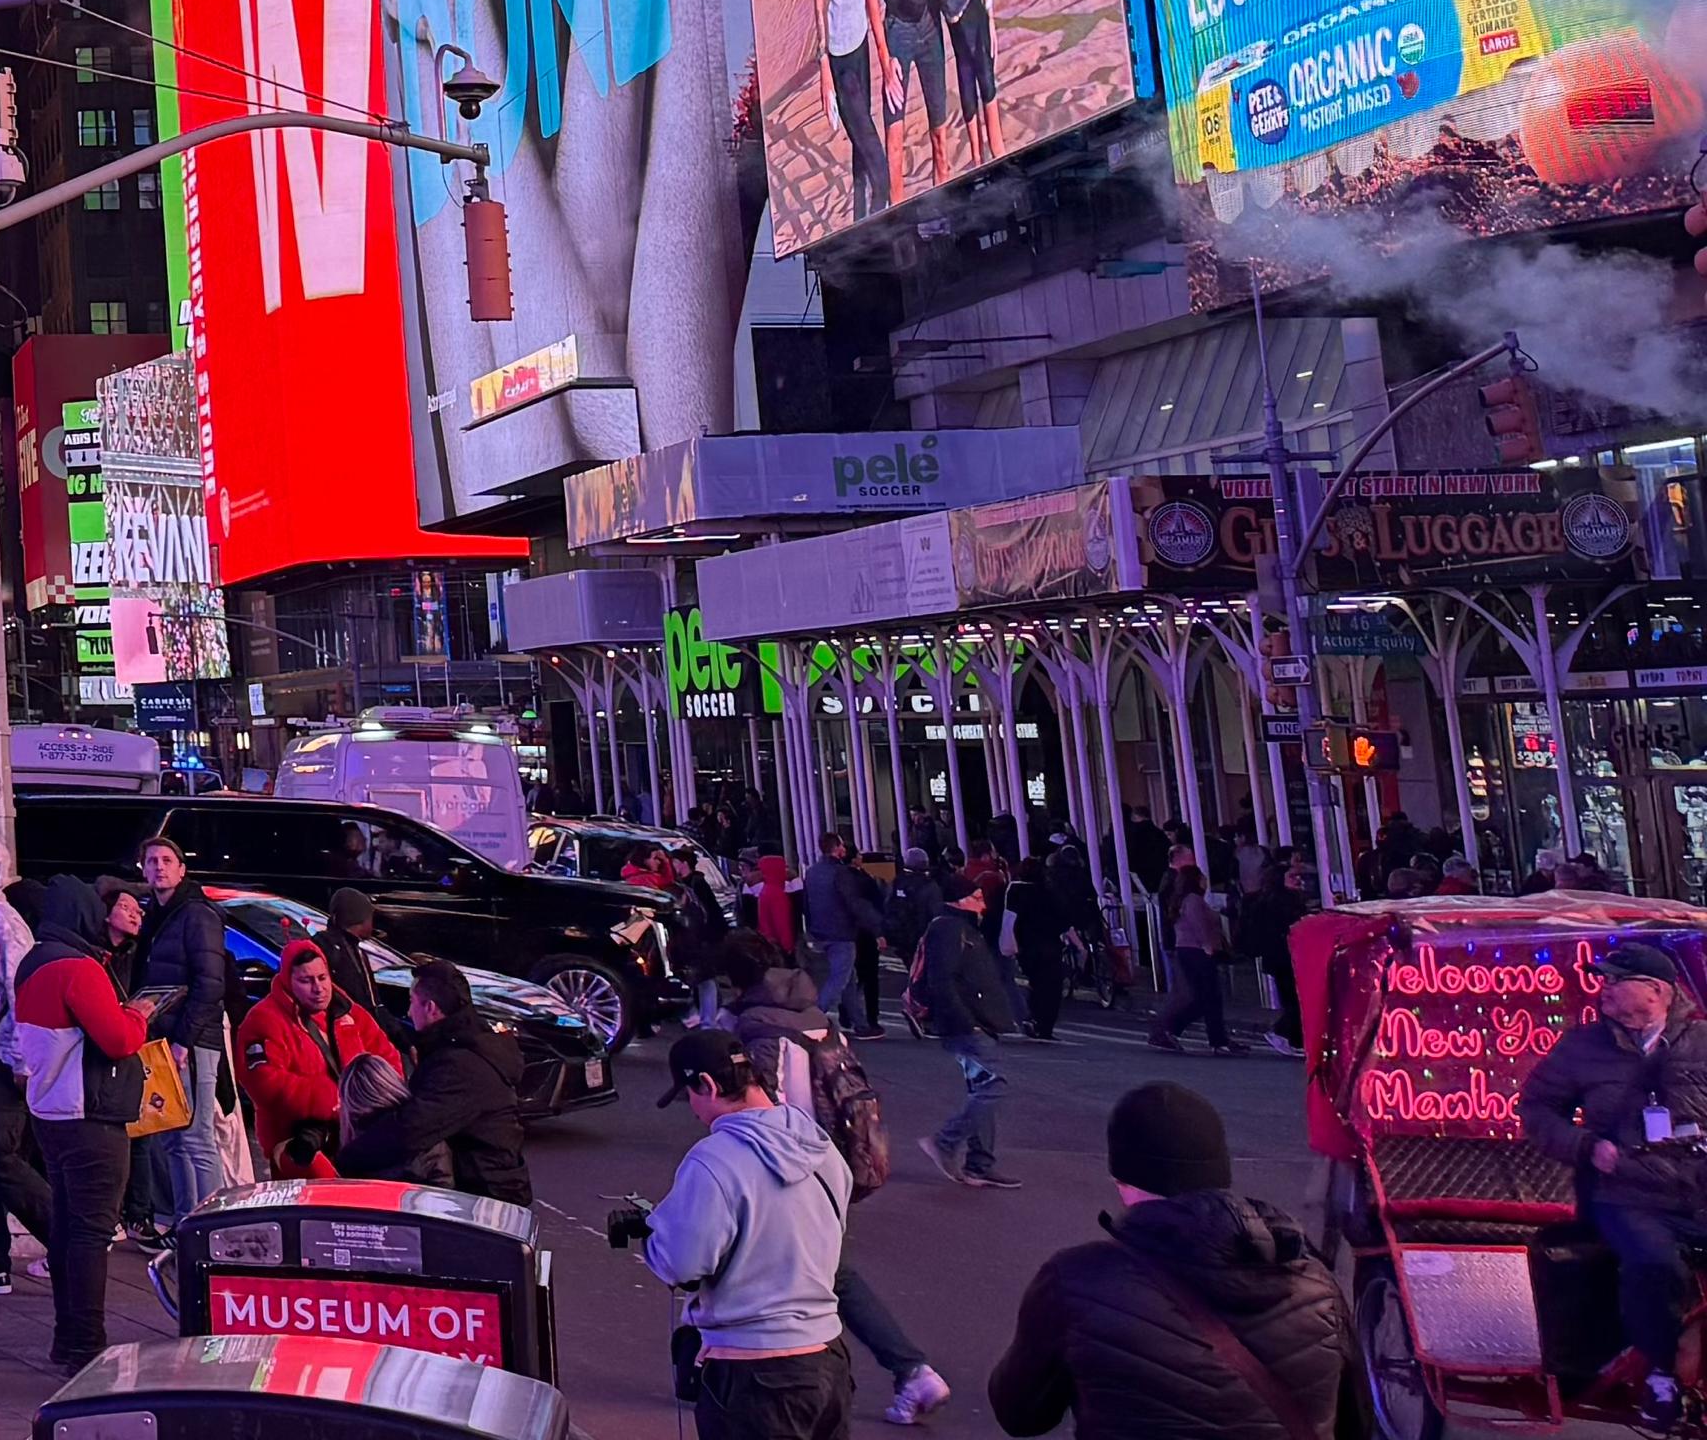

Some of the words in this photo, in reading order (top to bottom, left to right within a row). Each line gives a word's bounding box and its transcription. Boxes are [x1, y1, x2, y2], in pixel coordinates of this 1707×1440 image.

[1467, 2, 1518, 25] CERTIFIED
[1482, 33, 1517, 53] LARGE
[1288, 26, 1396, 109] ORGANIC
[1248, 86, 1274, 115] PETE
[832, 433, 941, 499] pelé
[858, 483, 922, 498] SOCCER
[1361, 476, 1416, 495] STORE
[1421, 474, 1440, 494] IN
[1444, 474, 1486, 494] NEW
[1489, 473, 1541, 493] YORK
[1373, 503, 1566, 560] LUGGAGE
[1329, 615, 1341, 632] W
[1349, 615, 1370, 631] 46
[1322, 634, 1368, 649] Actors'
[1373, 634, 1418, 651] Equity
[685, 691, 736, 718] SOCCER
[1376, 1008, 1487, 1058] New
[223, 1290, 412, 1340] MUSEUM
[428, 1307, 486, 1344] OF
